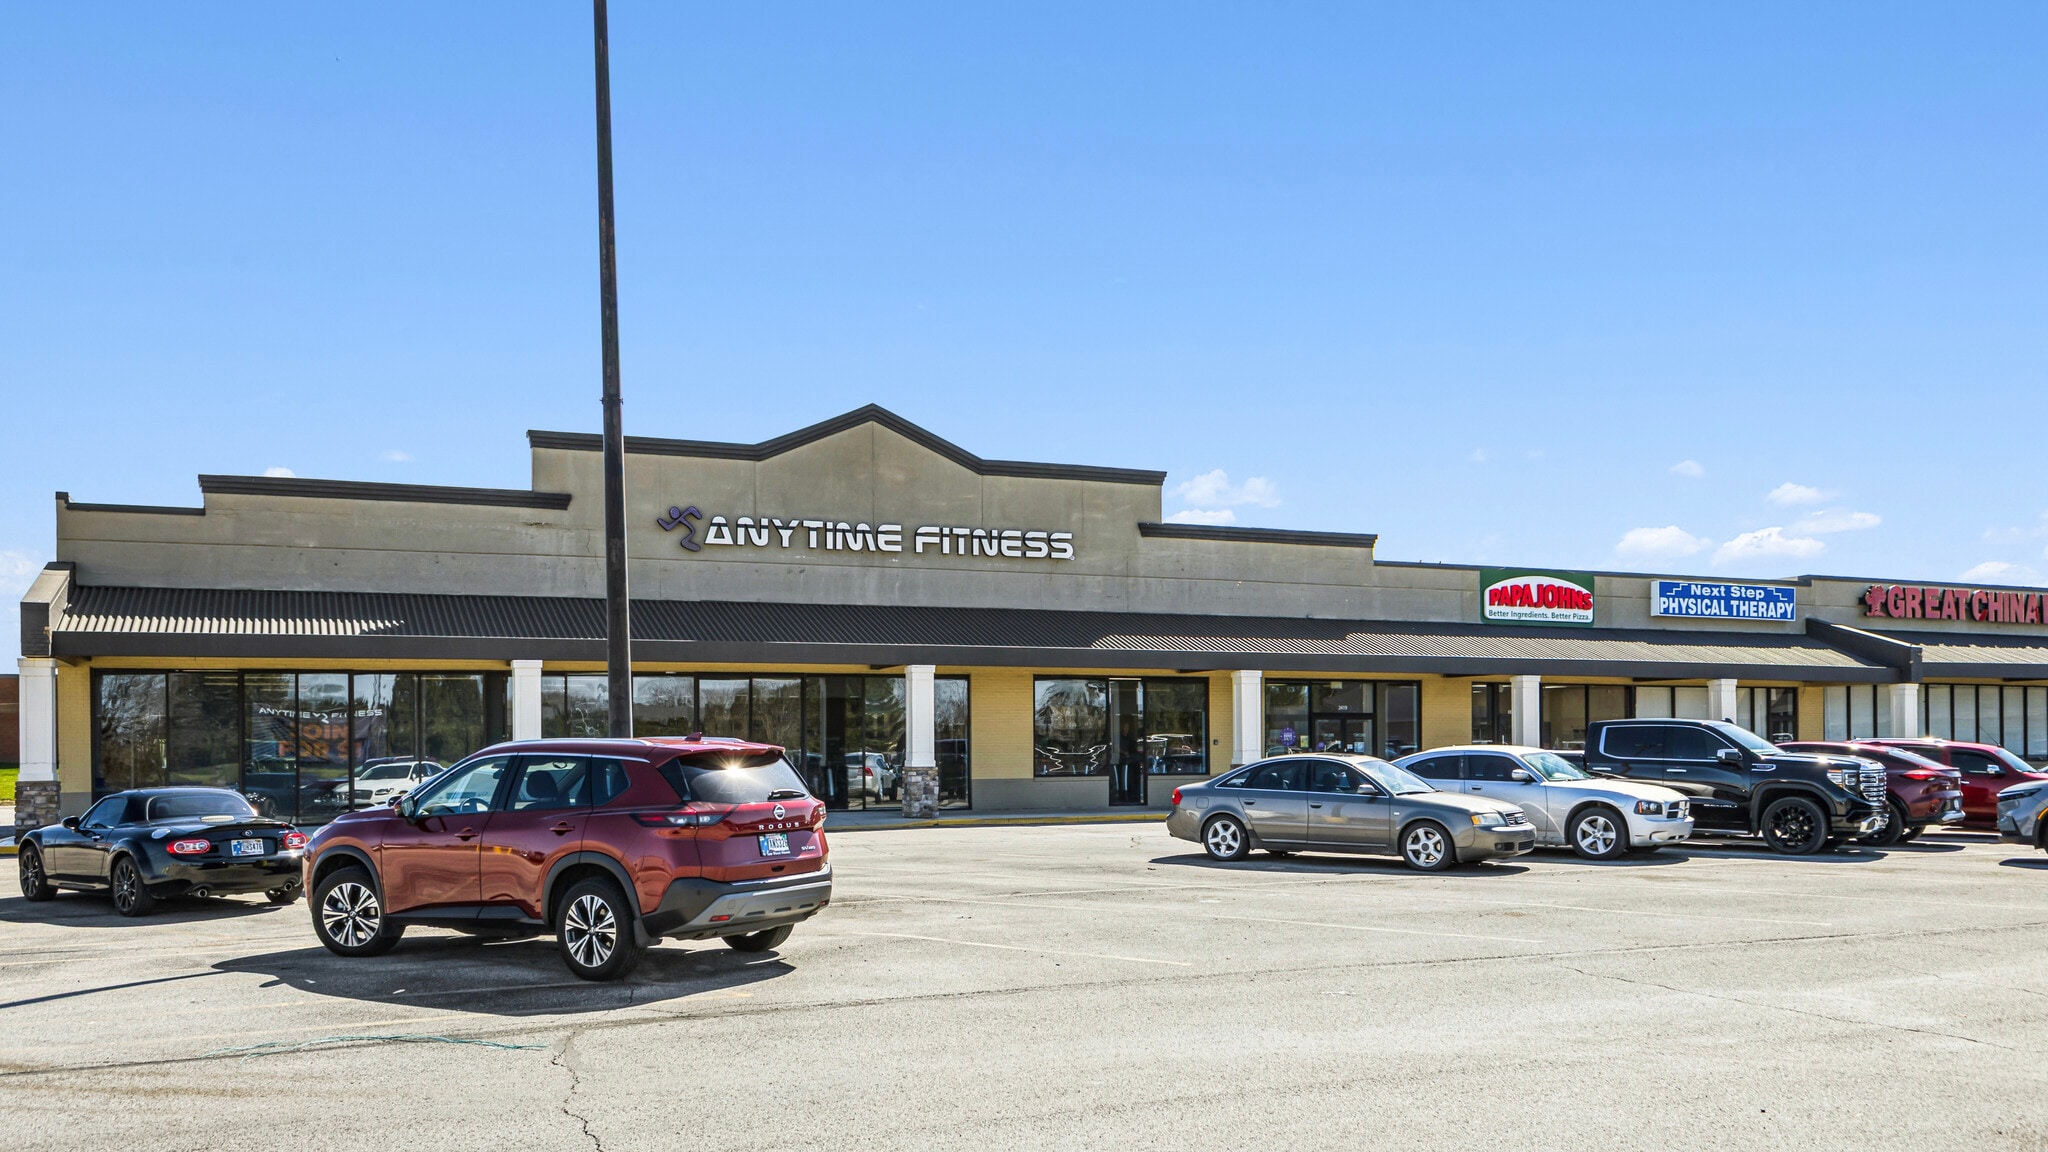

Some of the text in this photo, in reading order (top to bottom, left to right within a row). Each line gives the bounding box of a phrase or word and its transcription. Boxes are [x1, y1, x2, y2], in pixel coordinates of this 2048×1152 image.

[704, 515, 1073, 559] ANYTIME FITNESS
[1488, 583, 1593, 610] PAPA JOHNS
[1690, 584, 1765, 600] Next Step
[1488, 609, 1590, 620] Better Ingredients. Better Pizza.
[1660, 597, 1794, 618] PHYSICAL THERAPY
[1887, 585, 1969, 621] GREAT
[1972, 590, 2040, 625] CHINA
